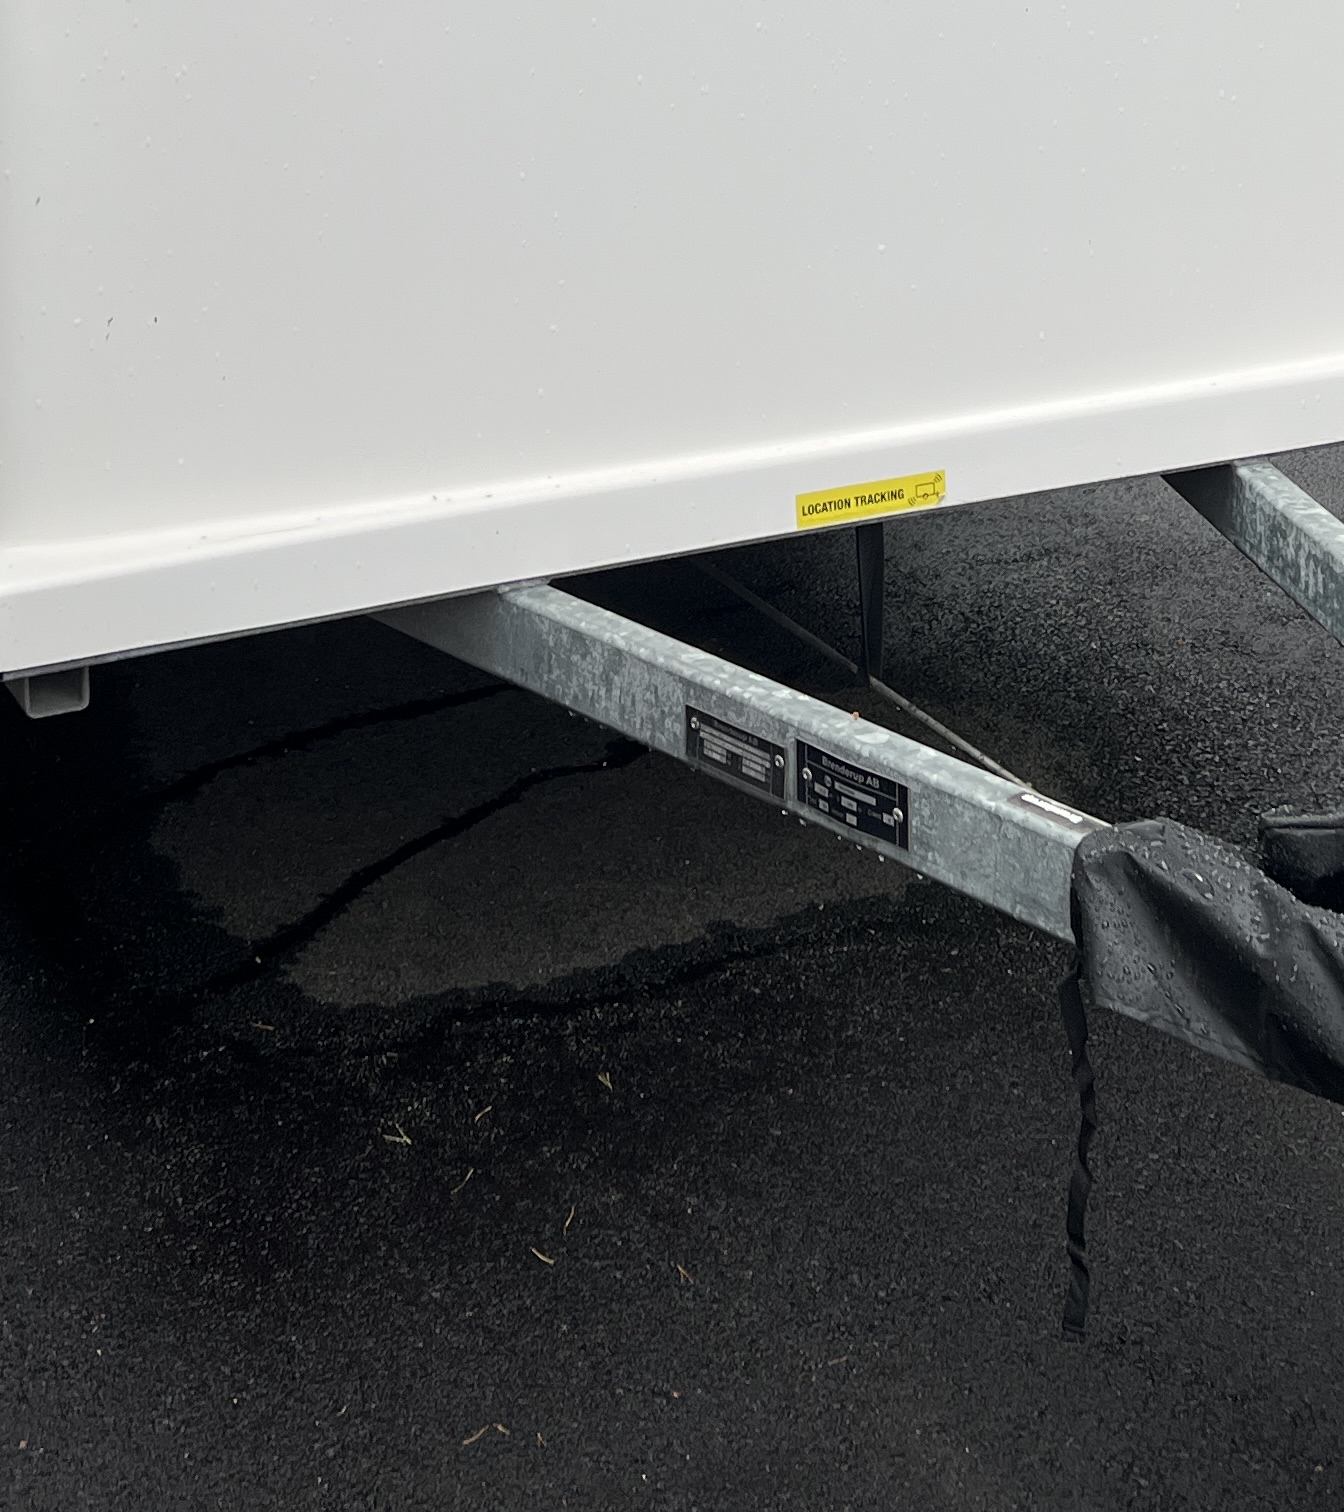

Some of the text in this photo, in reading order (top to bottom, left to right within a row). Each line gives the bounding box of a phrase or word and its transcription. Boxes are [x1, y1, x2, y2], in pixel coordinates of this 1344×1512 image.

[801, 488, 905, 517] LOCATION TRACKING
[866, 775, 880, 789] AB
